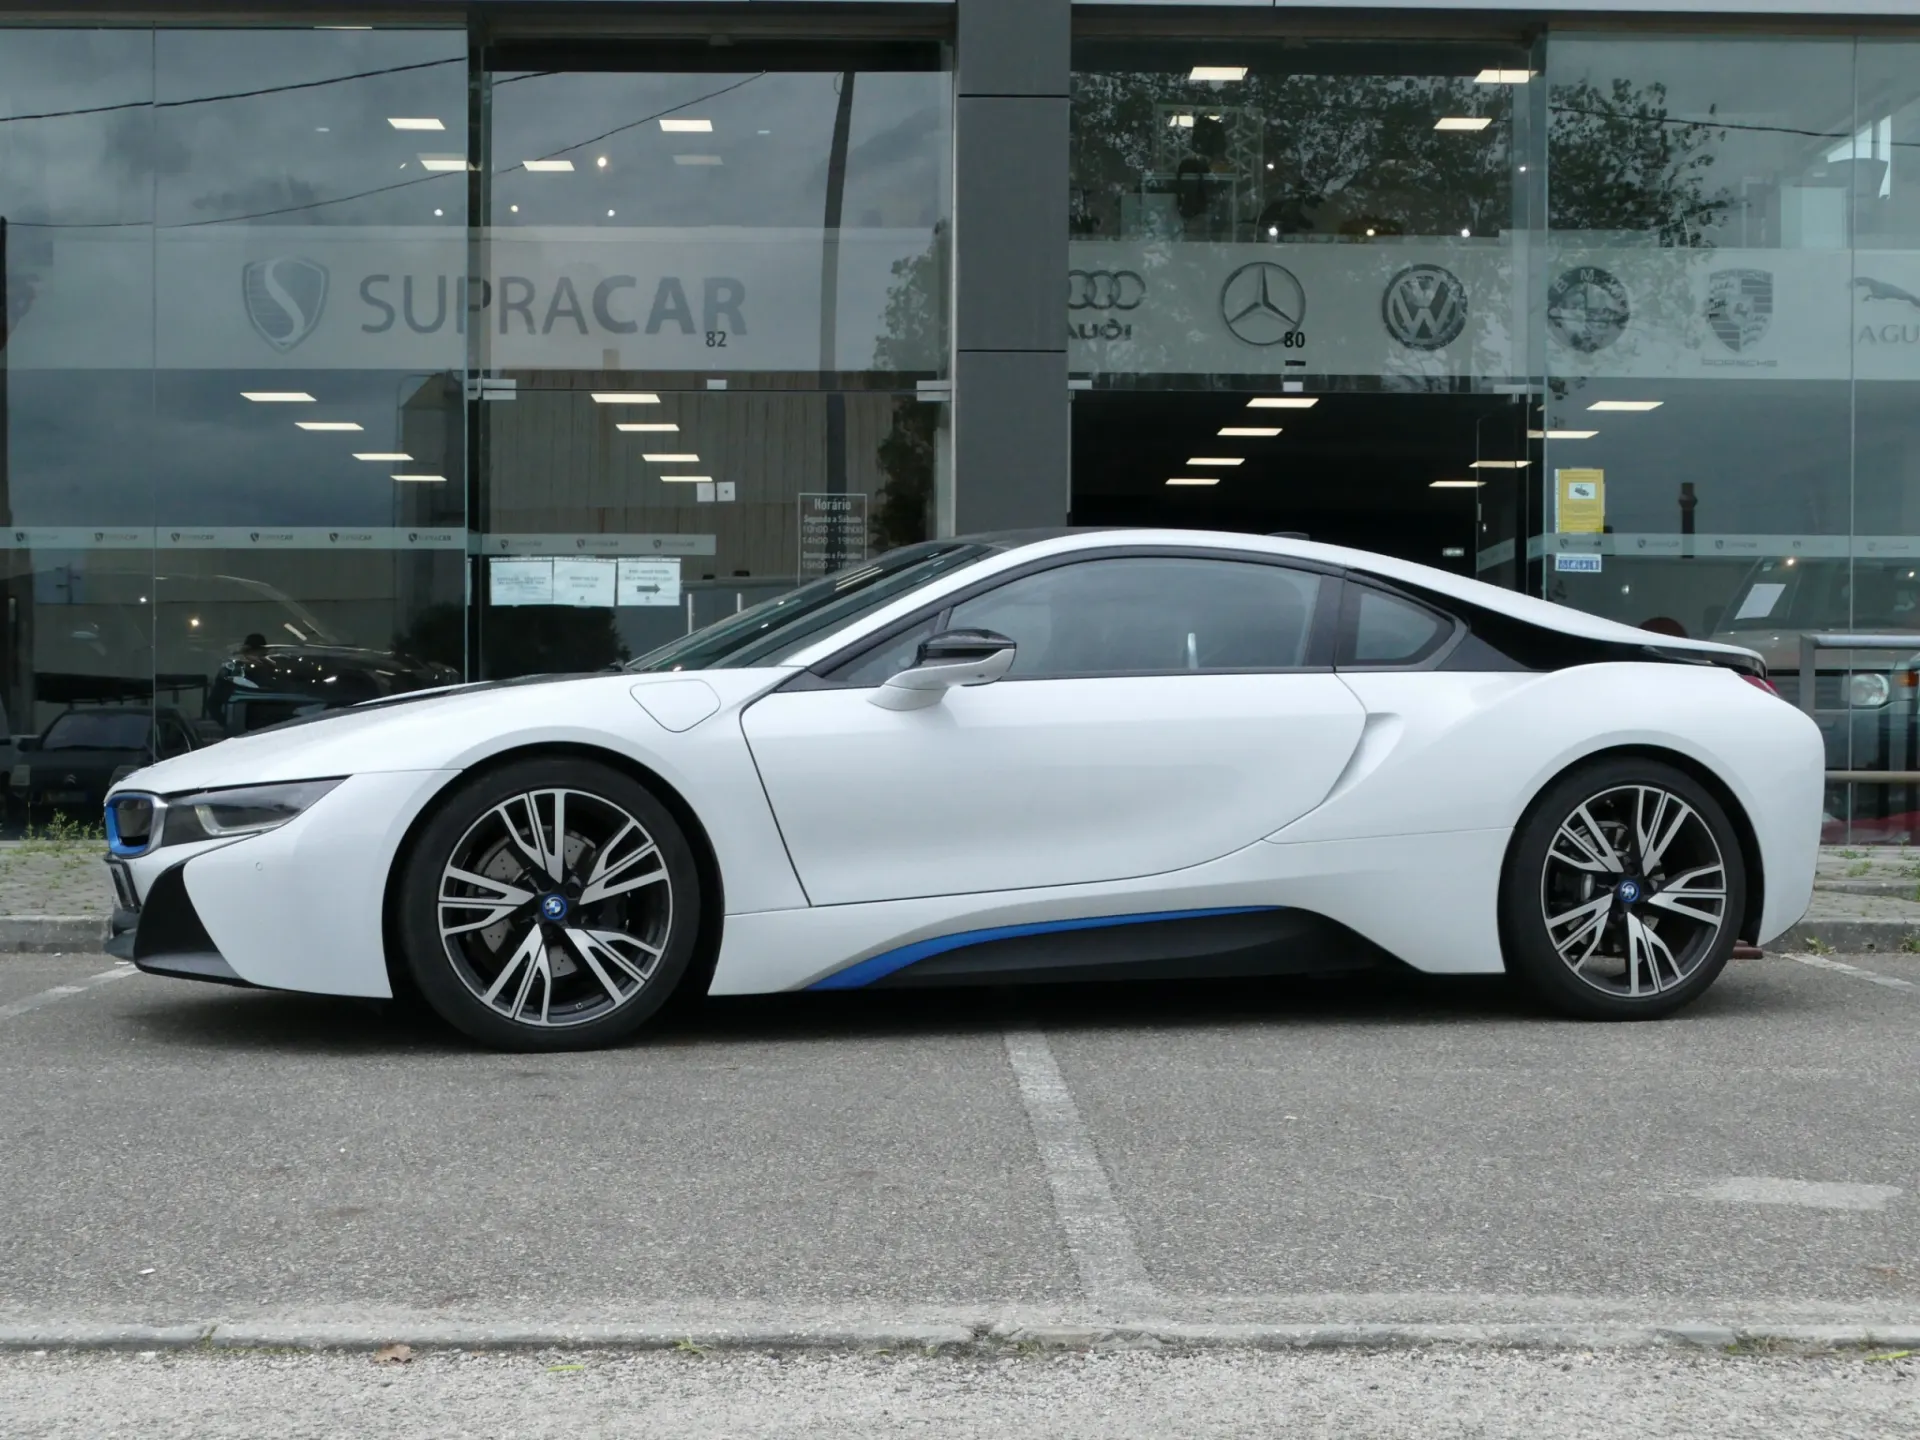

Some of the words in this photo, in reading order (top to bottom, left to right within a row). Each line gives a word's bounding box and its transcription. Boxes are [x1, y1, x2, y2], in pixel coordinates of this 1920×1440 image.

[359, 274, 747, 335] SUPRACAR
[705, 331, 727, 348] 82
[1284, 331, 1305, 348] 80
